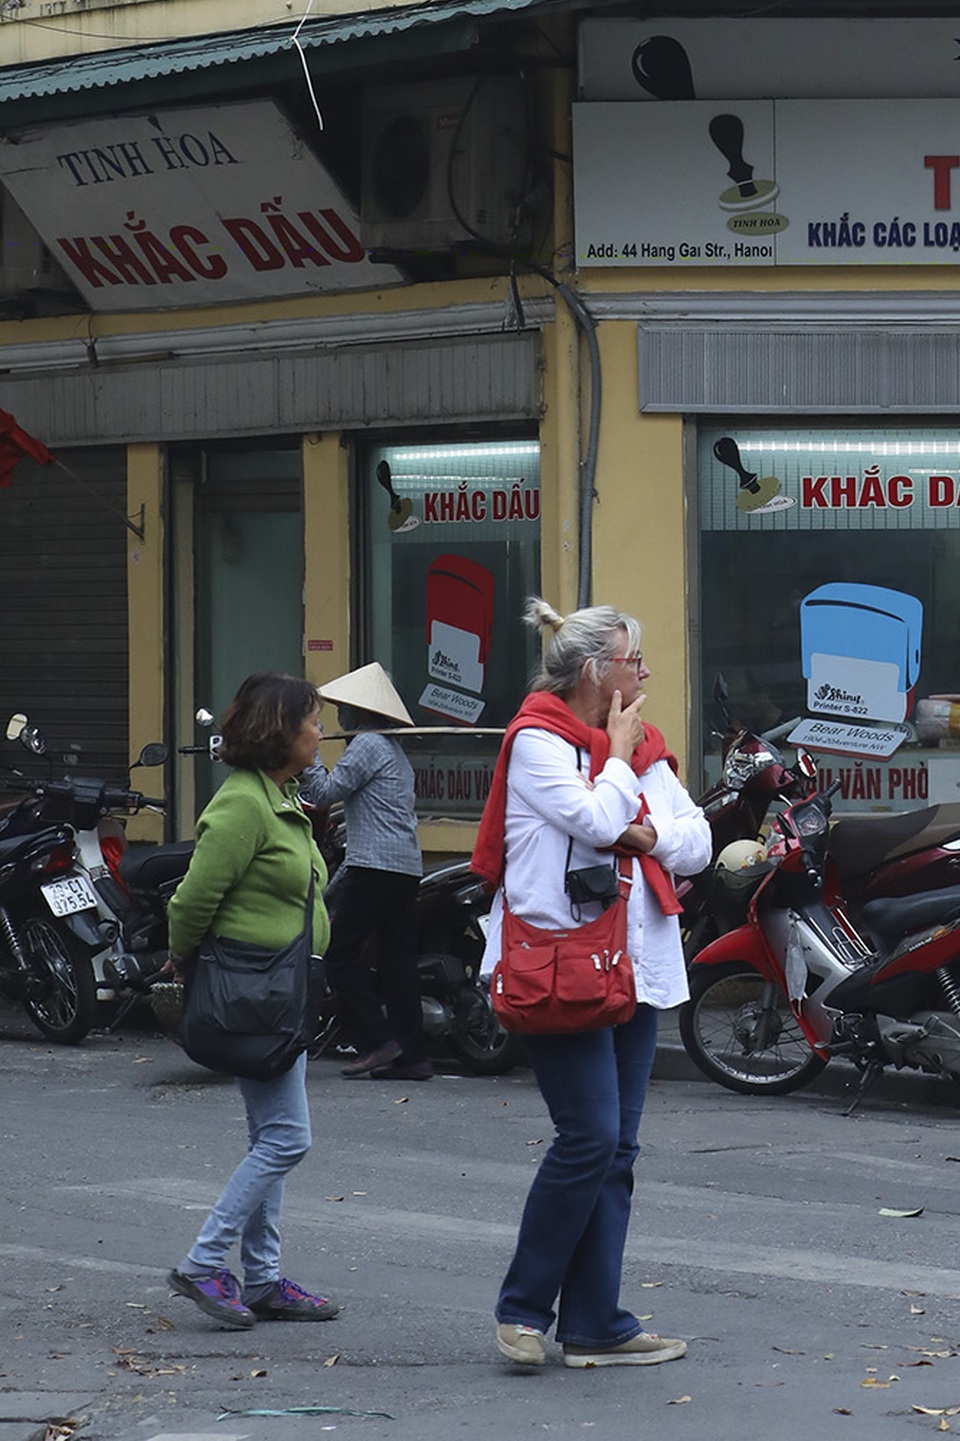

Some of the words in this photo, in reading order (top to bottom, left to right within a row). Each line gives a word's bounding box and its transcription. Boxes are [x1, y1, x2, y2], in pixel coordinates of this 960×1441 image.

[153, 130, 239, 171] HOA
[759, 217, 781, 228] HOA
[807, 213, 866, 248] KHẮC
[873, 216, 916, 248] CÁC
[57, 210, 229, 289] KHẮC
[587, 243, 618, 258] Add:
[622, 243, 637, 258] 44
[641, 243, 675, 262] Hang
[424, 480, 487, 523] KHẮC
[492, 477, 541, 522] DẤU
[802, 465, 914, 509] KHẮC
[431, 687, 451, 701] Bear
[451, 693, 479, 710] Woods
[813, 700, 842, 711] Printer
[809, 722, 845, 736] Bear
[846, 727, 895, 743] Woods
[446, 760, 472, 800] DẤU
[474, 761, 494, 800] VĂ
[839, 761, 882, 800] VĂN
[888, 761, 929, 800] PHÒ
